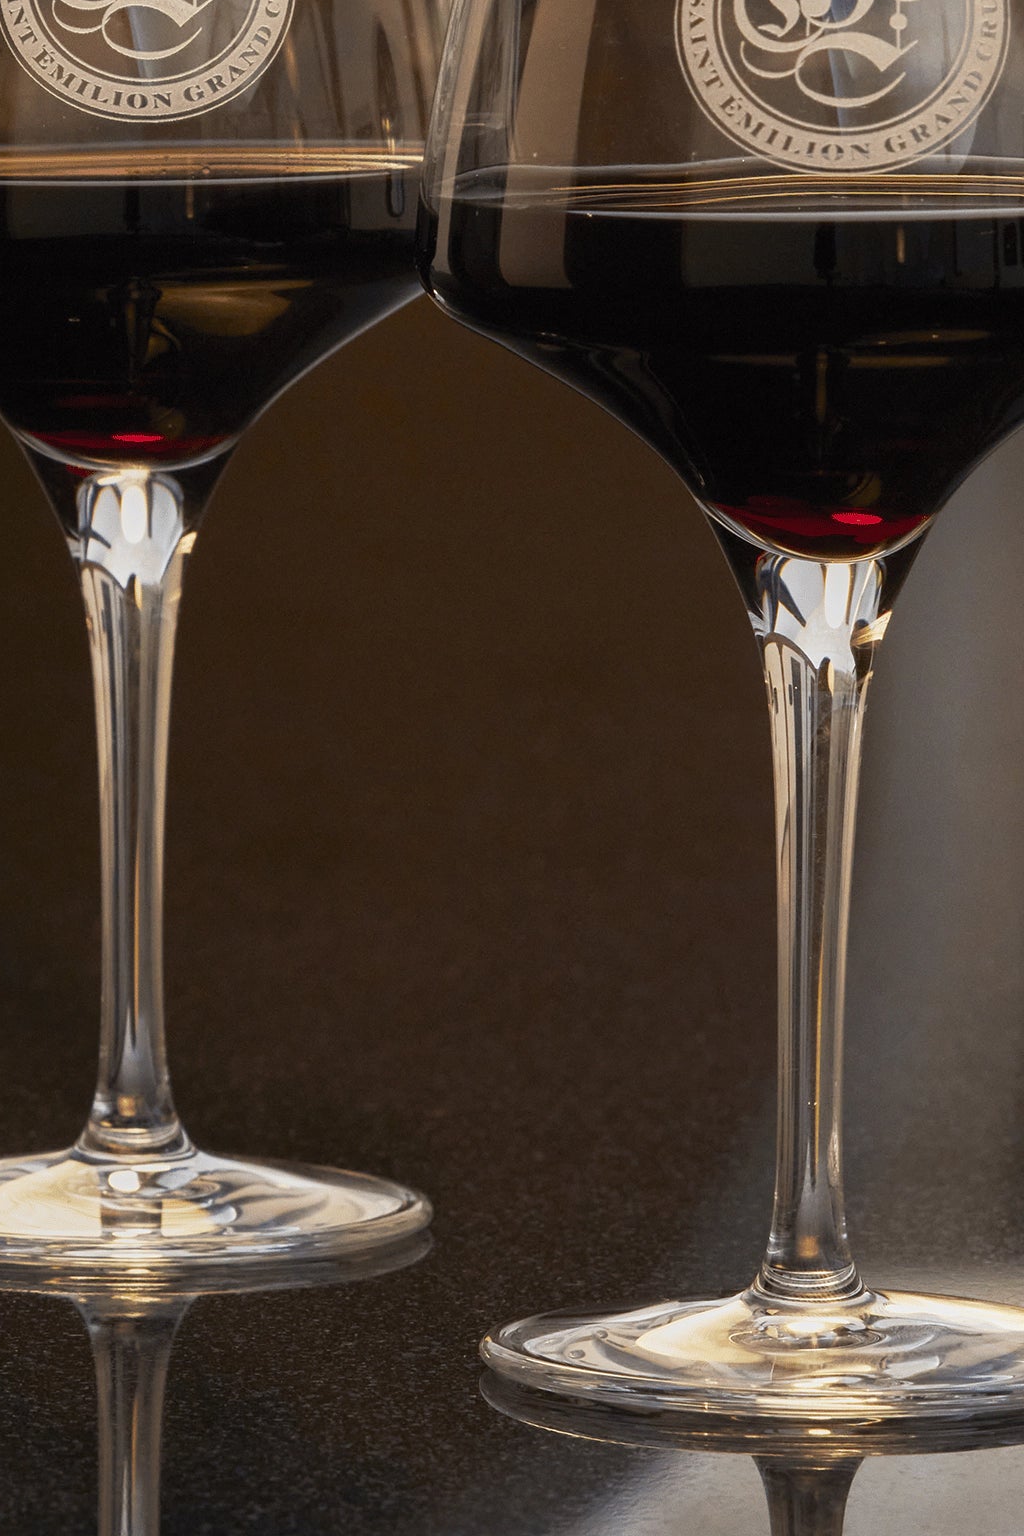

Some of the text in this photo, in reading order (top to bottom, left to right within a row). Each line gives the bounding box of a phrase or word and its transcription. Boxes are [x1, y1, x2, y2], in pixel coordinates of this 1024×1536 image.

[32, 43, 172, 109] ÉMILION
[183, 24, 273, 102] GRAND
[720, 95, 871, 162] ÉMILION
[883, 70, 984, 155] GRAND
